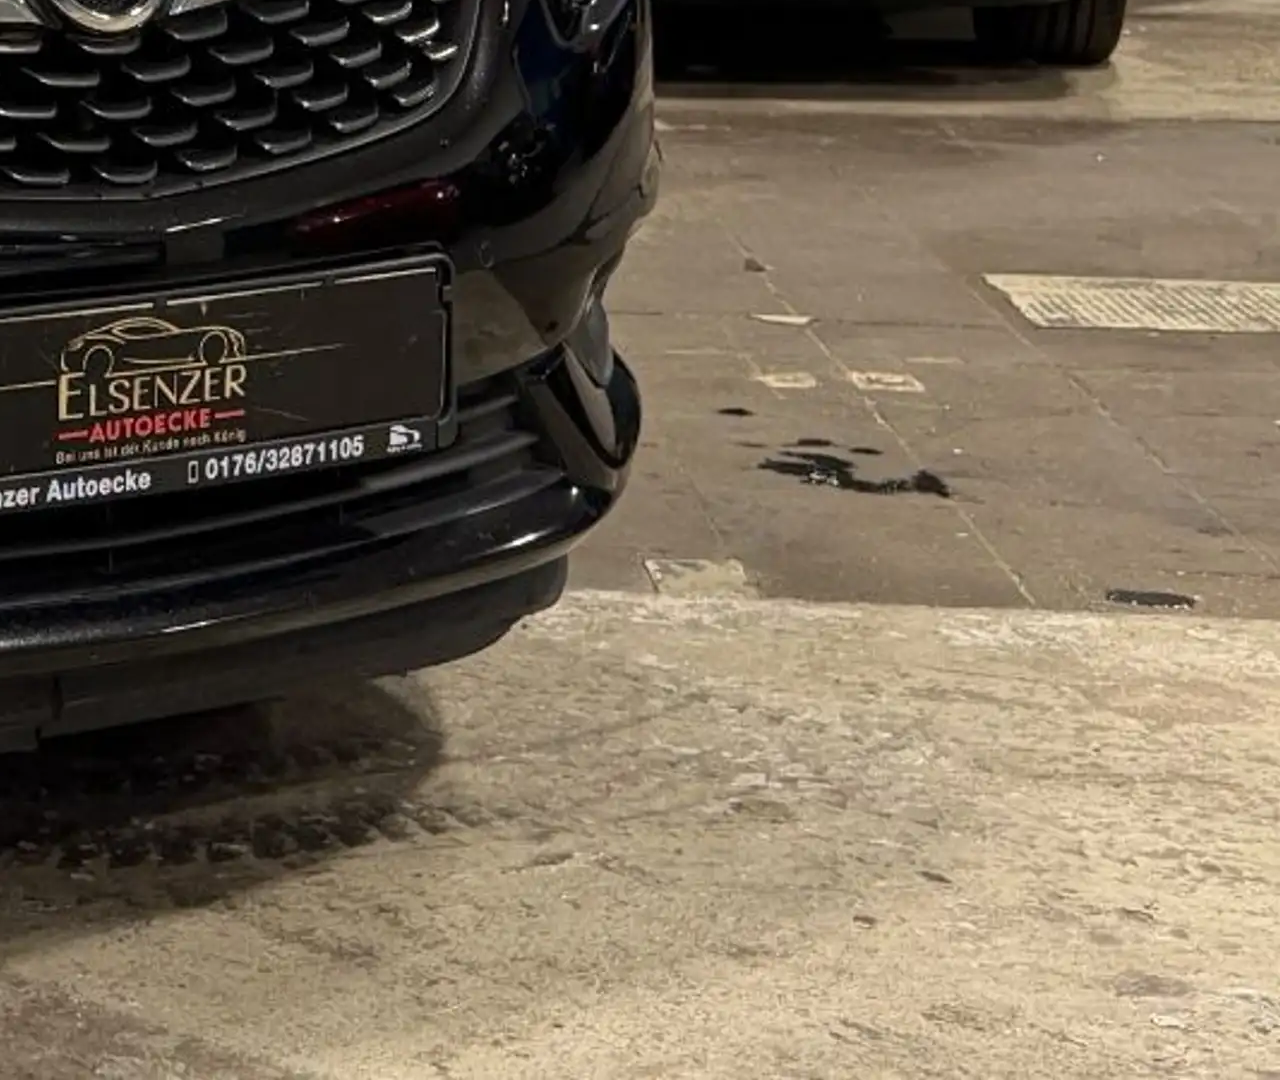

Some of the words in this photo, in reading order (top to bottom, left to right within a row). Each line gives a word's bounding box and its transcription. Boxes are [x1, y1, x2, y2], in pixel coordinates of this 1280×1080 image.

[57, 363, 248, 421] ELSENZER
[89, 407, 212, 444] AUTOECKE
[46, 469, 152, 503] Autoecke
[204, 434, 365, 480] 0176/32871105
